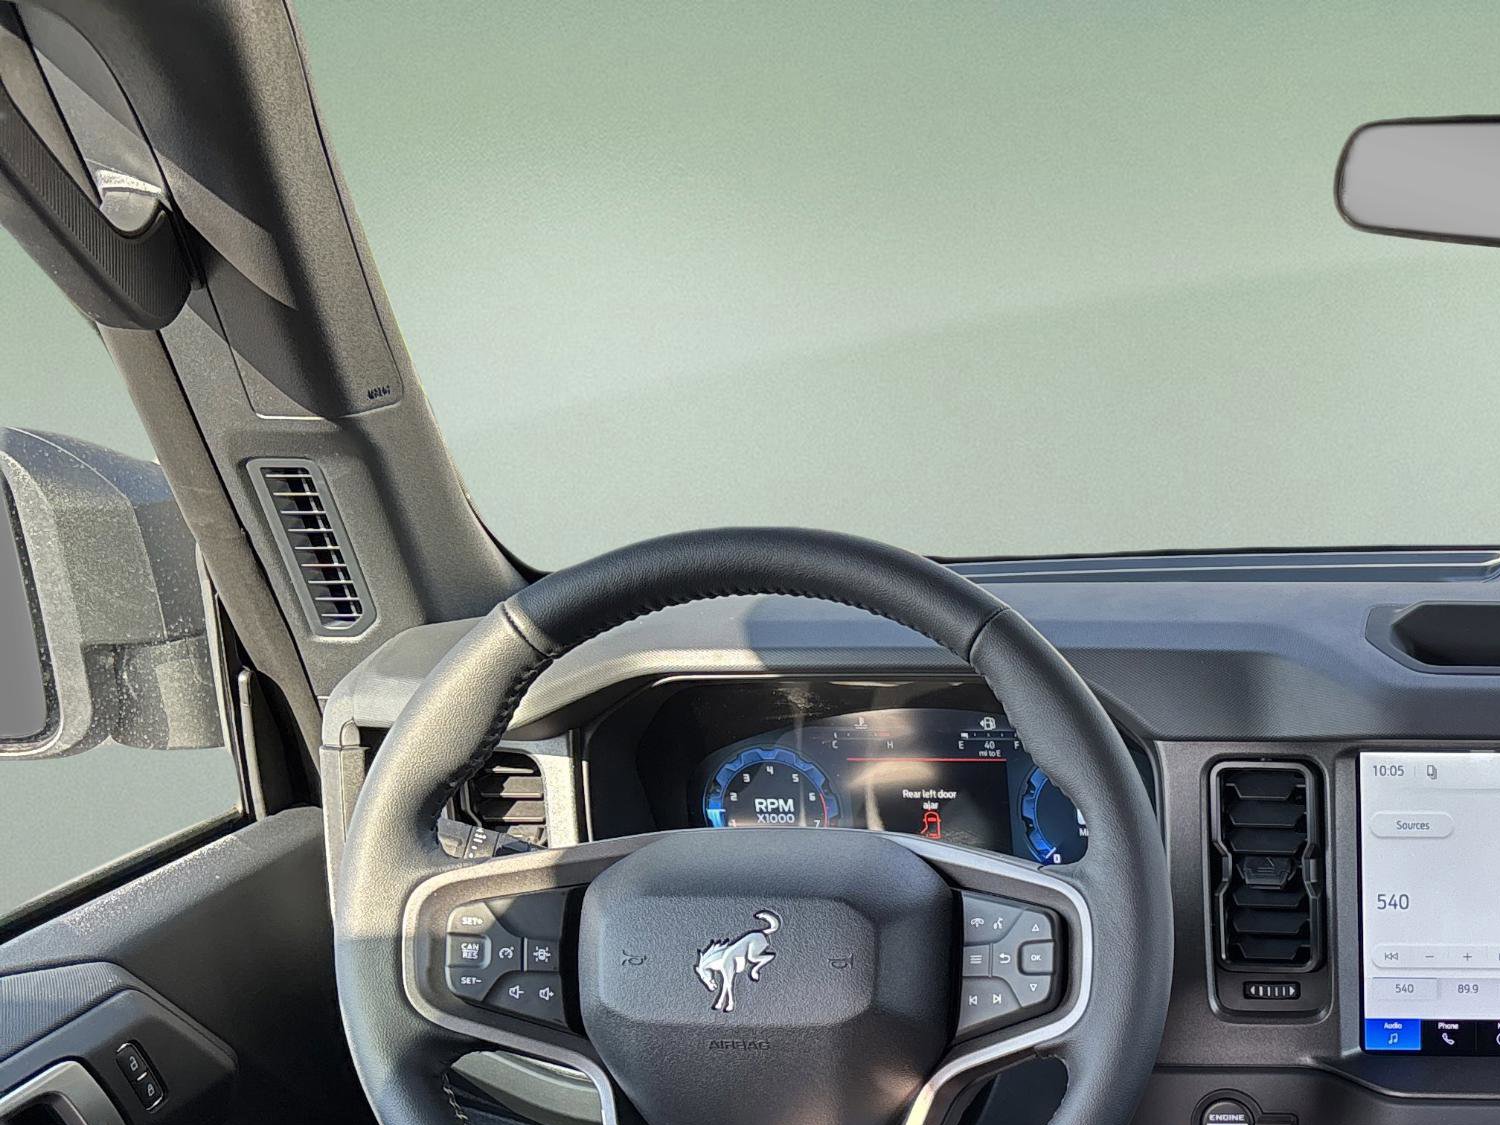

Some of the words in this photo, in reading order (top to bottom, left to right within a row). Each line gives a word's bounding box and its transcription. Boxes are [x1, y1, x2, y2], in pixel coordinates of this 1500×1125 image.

[887, 741, 894, 749] H
[958, 741, 964, 749] E
[984, 741, 996, 749] 40
[766, 766, 774, 774] 4
[1372, 766, 1404, 776] 10:05
[743, 774, 750, 782] 3
[792, 774, 799, 782] 5
[730, 793, 738, 801] 2
[809, 793, 816, 801] 6
[902, 790, 920, 798] Rear
[922, 790, 936, 798] left
[938, 790, 956, 798] door
[754, 799, 794, 812] RPM
[923, 801, 939, 810] ajar
[757, 814, 795, 823] X1000
[1396, 820, 1430, 830] Sources
[1376, 894, 1410, 910] 540
[460, 943, 479, 951] CAN
[1396, 984, 1414, 994] 540
[1458, 984, 1478, 994] 89.9
[1384, 1022, 1402, 1030] Audio
[1438, 1022, 1458, 1030] Phone
